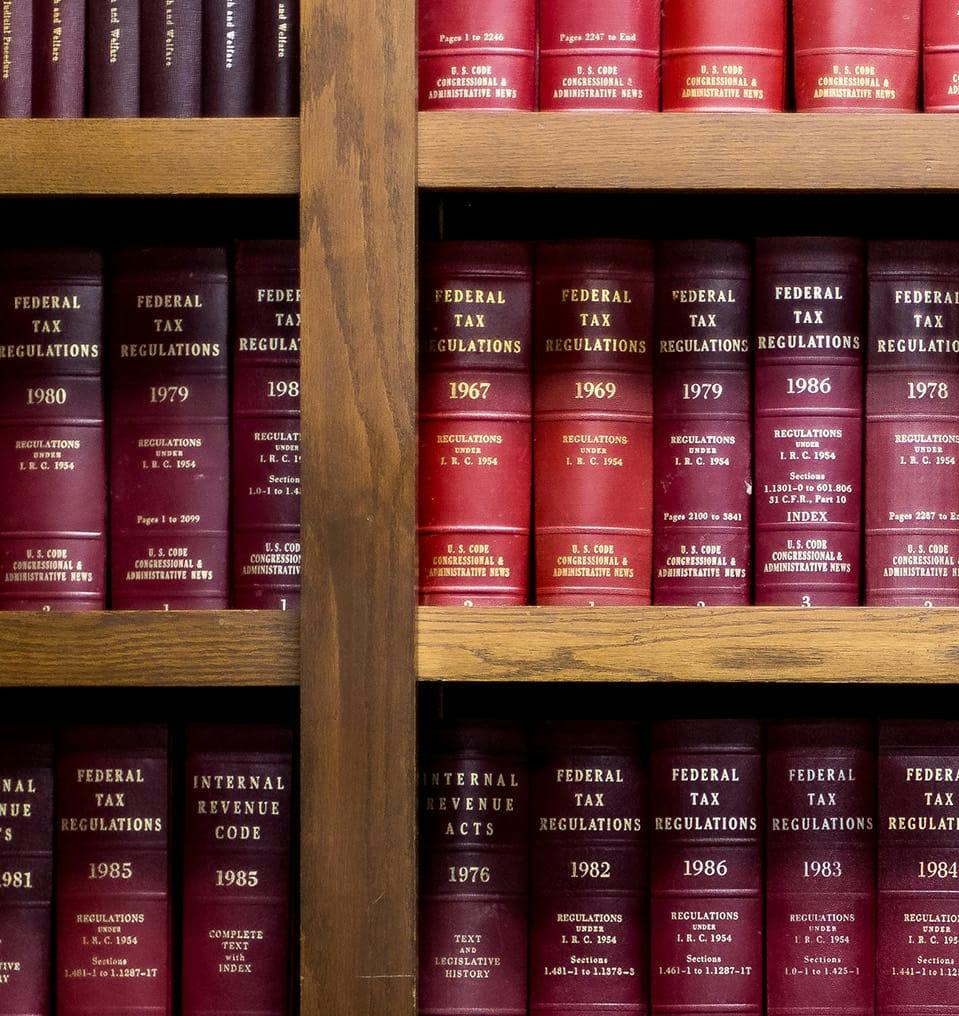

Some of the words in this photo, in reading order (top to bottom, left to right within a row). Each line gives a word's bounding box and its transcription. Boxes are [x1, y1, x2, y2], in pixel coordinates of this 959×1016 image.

[278, 3, 287, 20] and
[226, 10, 235, 28] and
[277, 23, 287, 58] Welfare
[440, 33, 461, 44] Pages
[465, 33, 469, 44] 1
[472, 33, 480, 44] to
[165, 29, 175, 66] Welfare
[225, 30, 236, 69] Welfare
[451, 66, 459, 75] U.
[462, 66, 468, 75] S.
[472, 66, 492, 75] CODE
[437, 77, 497, 87] CONGRESSIONAL
[501, 77, 507, 87] &
[429, 89, 492, 99] ADMINISTRATIVE
[496, 89, 517, 99] NEWS
[562, 289, 631, 303] FEDERAL
[775, 287, 842, 300] FEDERAL
[137, 295, 202, 308] FEDERAL
[580, 314, 611, 326] TAX
[794, 311, 823, 324] TAX
[154, 319, 183, 332] TAX
[546, 339, 646, 353] REGULATIONS
[758, 336, 861, 349] REGULATIONS
[121, 344, 220, 357] REGULATIONS
[449, 382, 490, 399] 1967
[575, 382, 616, 399] 1969
[787, 378, 831, 394] 1986
[907, 383, 948, 399] 1978
[27, 388, 66, 406] 1980
[150, 386, 189, 402] 1979
[774, 429, 842, 438] REGULATIONS
[780, 452, 787, 460] I.
[790, 452, 800, 460] R.
[802, 452, 812, 460] C.
[814, 452, 836, 460] 1954
[790, 472, 825, 480] Sections
[806, 484, 814, 493] to
[769, 495, 778, 505] 31
[815, 495, 834, 505] Part
[836, 495, 846, 505] 10
[664, 513, 685, 523] Pages
[712, 513, 720, 523] to
[787, 512, 828, 522] INDEX
[772, 551, 835, 561] CONGRESSIONAL
[836, 551, 842, 561] &
[764, 562, 827, 572] ADMINISTRATIVE
[830, 562, 851, 572] NEWS
[193, 776, 285, 790] INTERNAL
[198, 800, 280, 814] REVENUE
[215, 826, 261, 840] CODE
[446, 822, 494, 836] ACTS
[88, 863, 132, 879] 1985
[448, 866, 490, 883] 1976
[570, 861, 611, 878] 1982
[683, 860, 727, 876] 1986
[802, 861, 842, 877] 1983
[917, 861, 958, 878] 1984
[215, 871, 258, 886] 1985
[454, 935, 481, 943] TEXT
[435, 957, 501, 966] LEGISLATIVE
[445, 969, 490, 978] HISTORY
